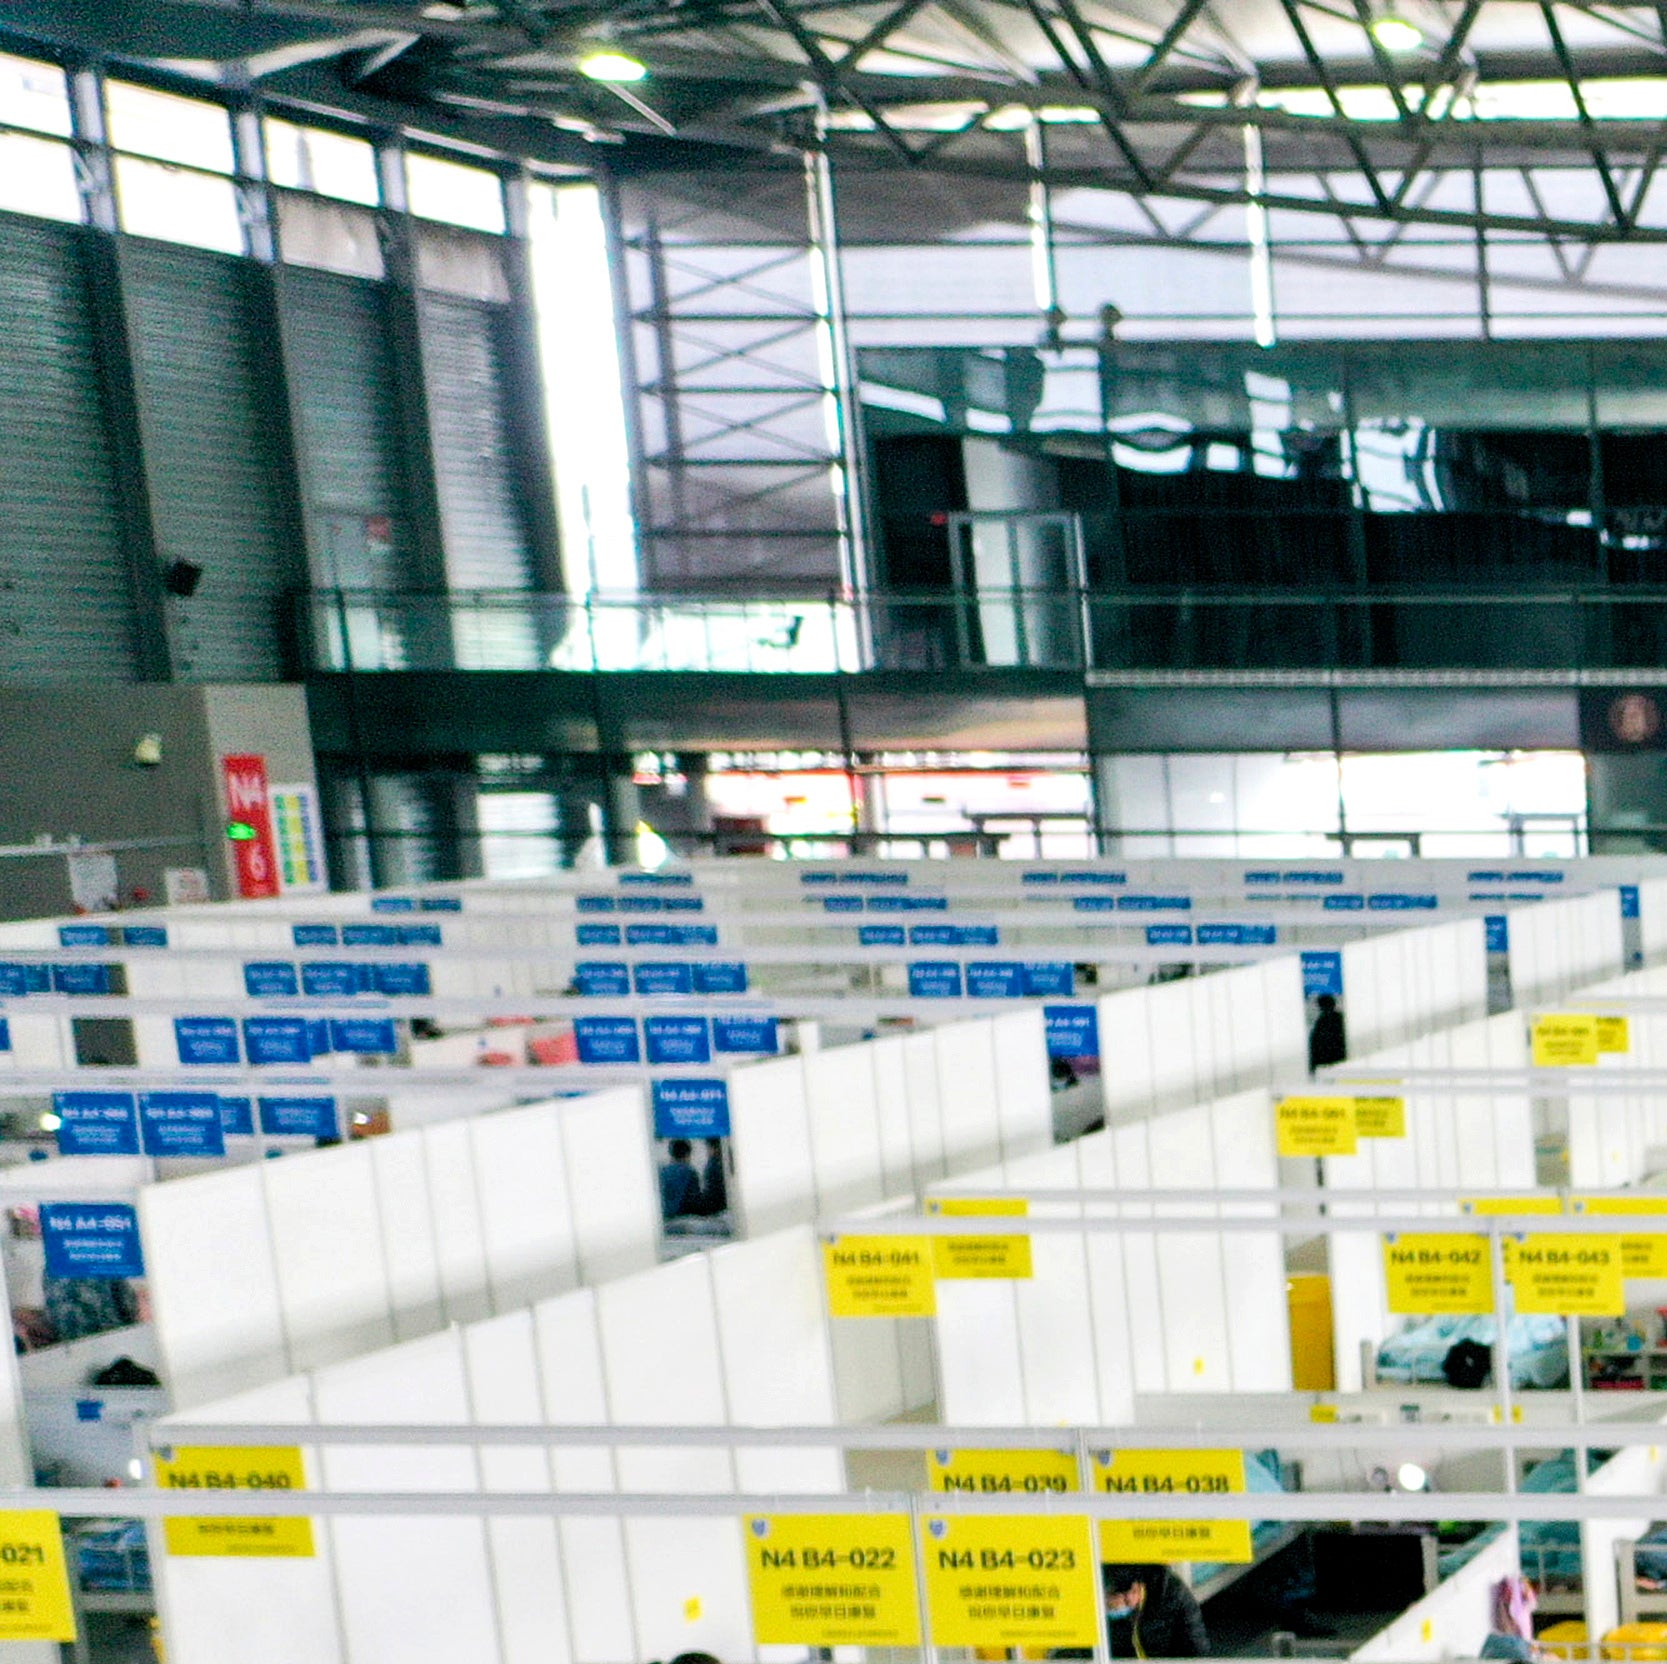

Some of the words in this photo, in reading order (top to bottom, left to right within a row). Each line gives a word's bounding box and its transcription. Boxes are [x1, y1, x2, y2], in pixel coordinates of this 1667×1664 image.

[228, 773, 260, 806] N4
[249, 851, 265, 880] 6
[944, 1476, 976, 1492] N4
[981, 1476, 1067, 1492] B4-039
[1106, 1476, 1138, 1492] N4
[1143, 1476, 1229, 1492] B4-038
[761, 1549, 796, 1569] N4
[802, 1549, 894, 1569] B4-022
[939, 1550, 974, 1569] N4
[981, 1550, 1075, 1569] B4-023
